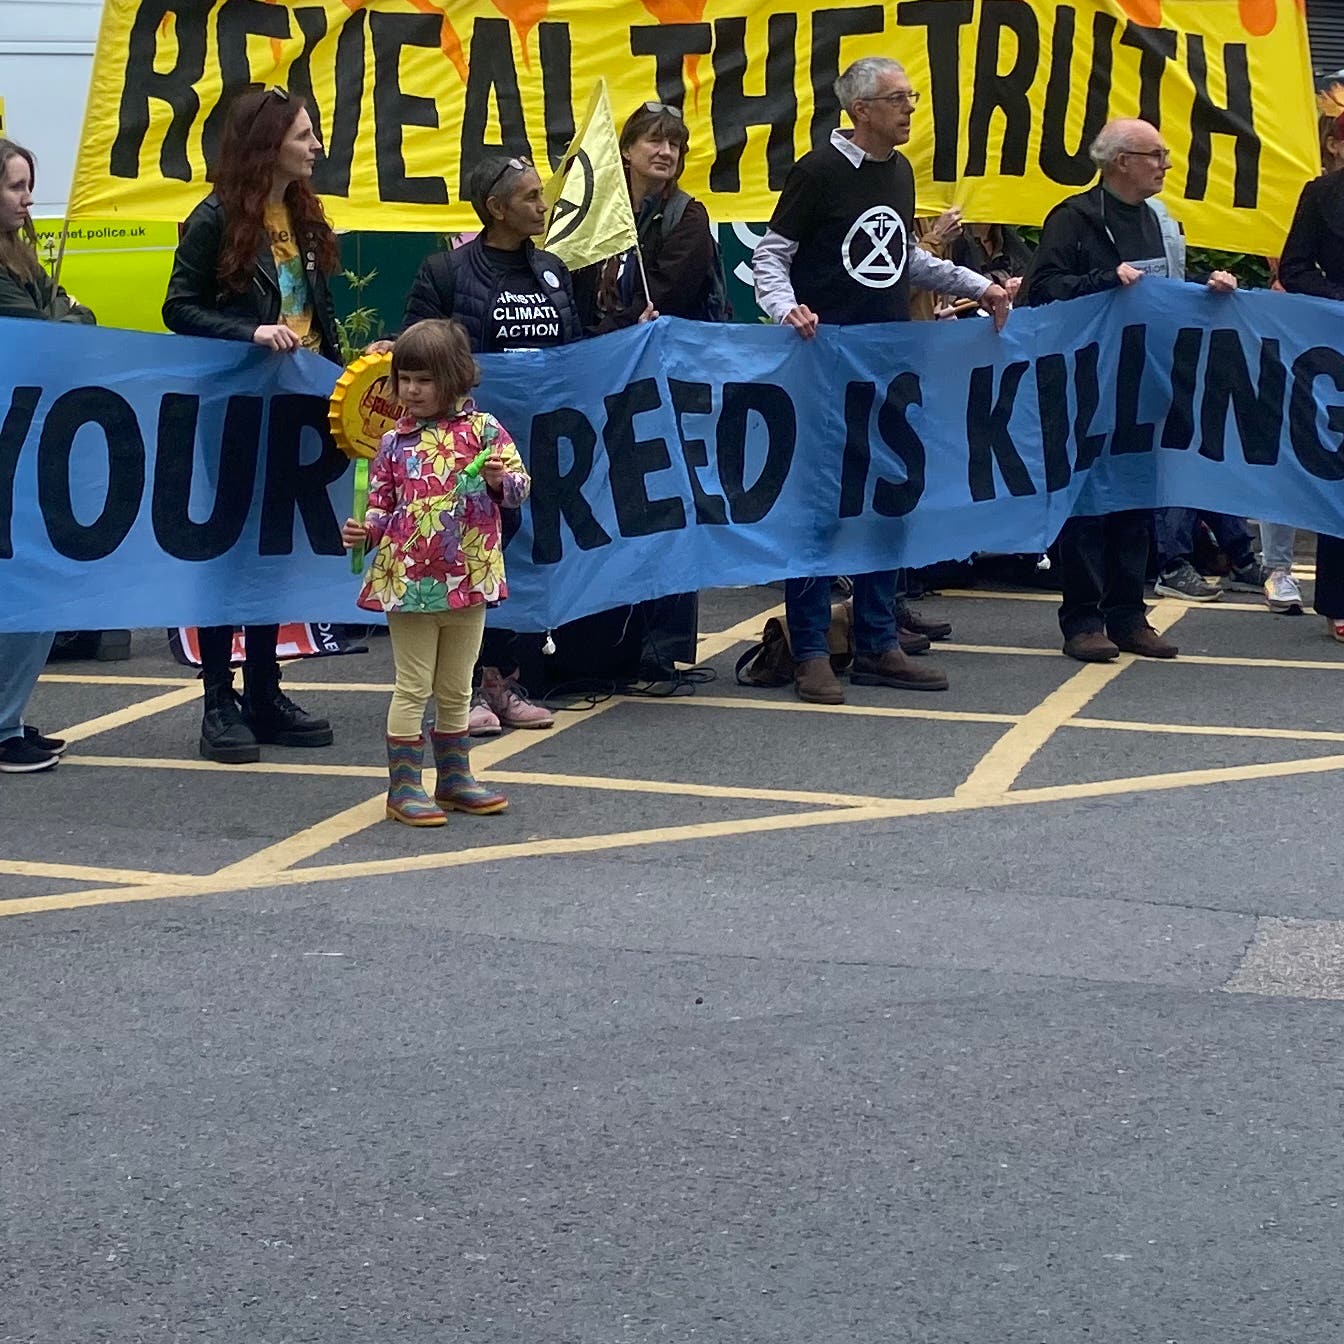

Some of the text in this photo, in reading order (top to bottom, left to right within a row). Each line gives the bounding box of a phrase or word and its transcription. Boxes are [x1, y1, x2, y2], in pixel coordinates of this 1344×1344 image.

[630, 5, 885, 193] THE
[495, 323, 560, 338] ACTION
[504, 377, 796, 564] REED
[838, 372, 926, 519] IS
